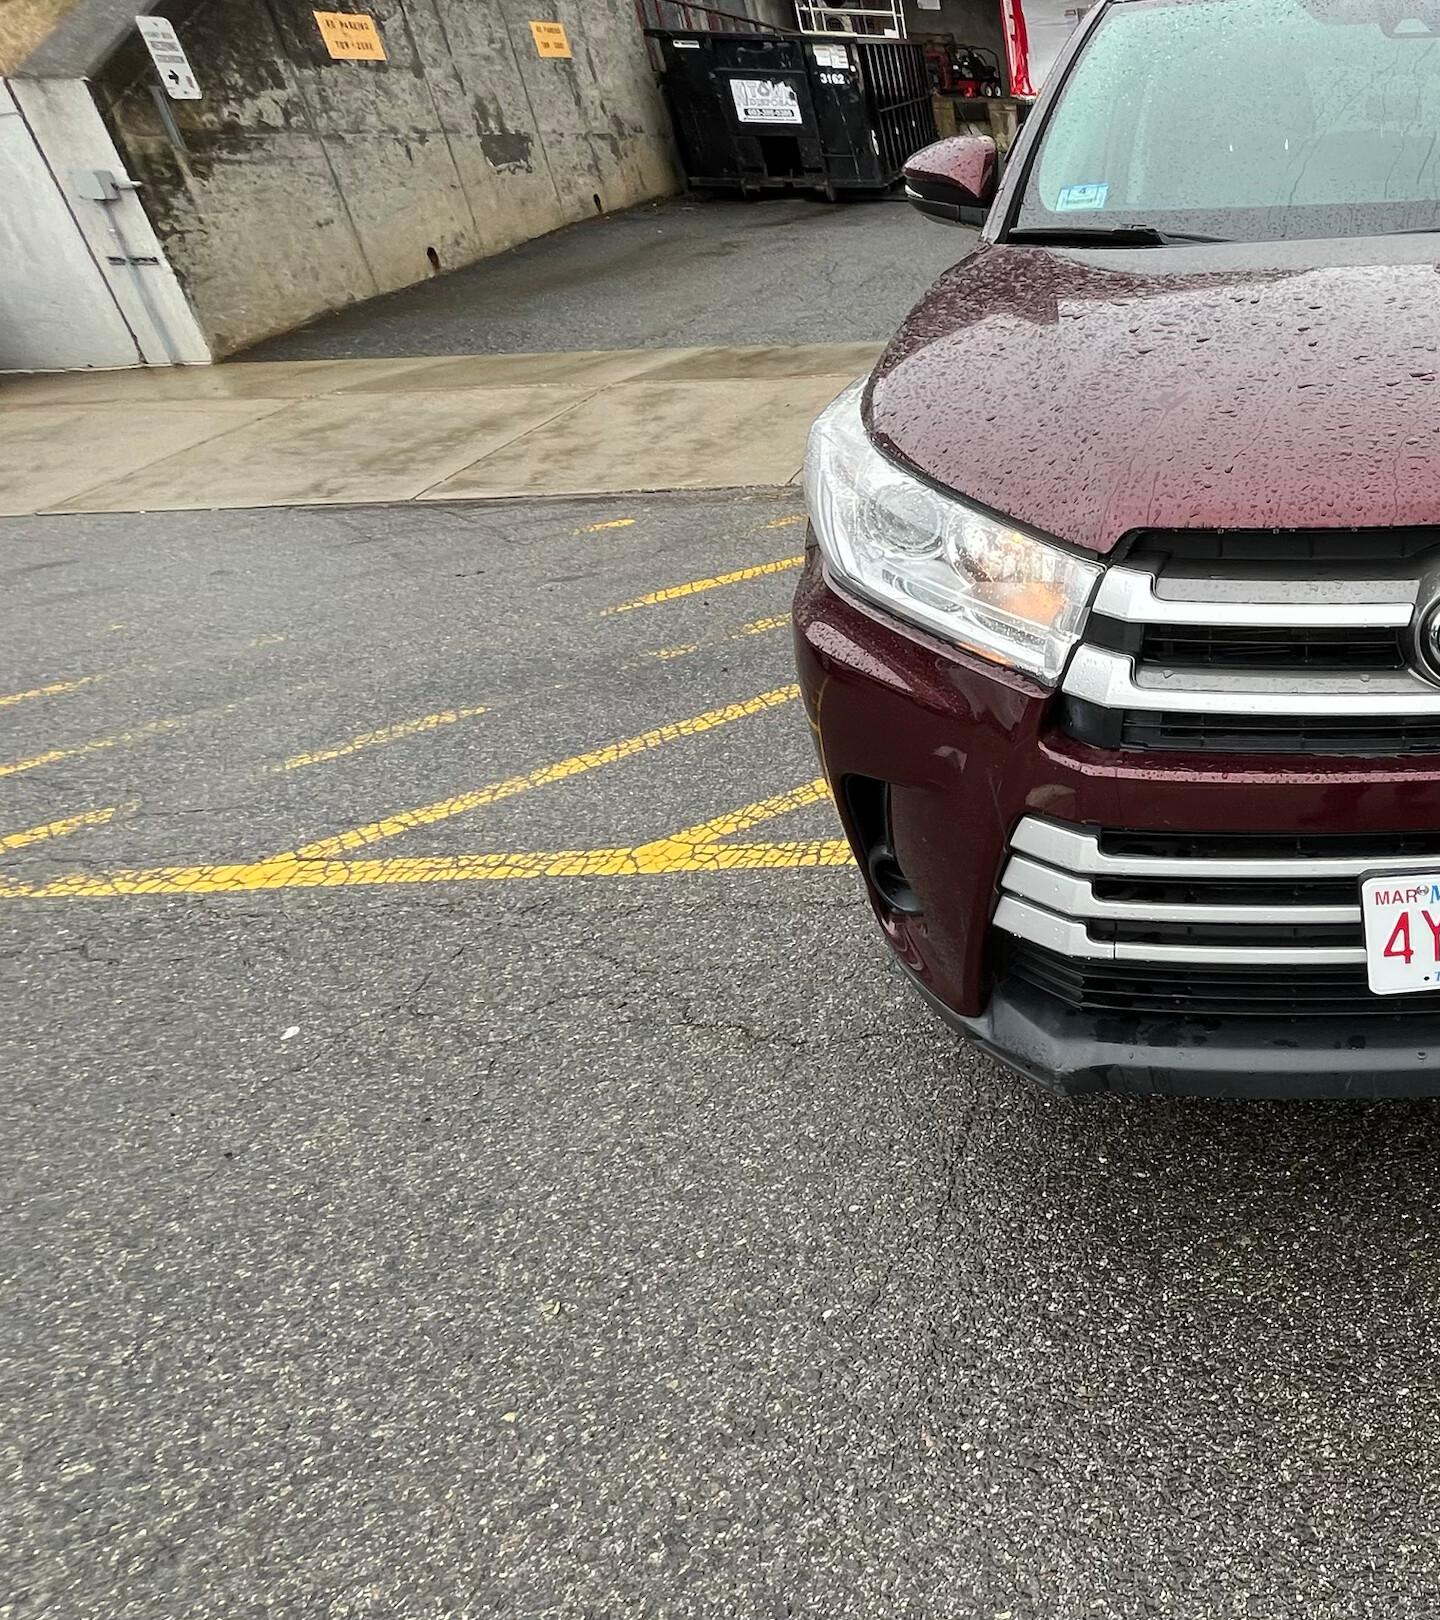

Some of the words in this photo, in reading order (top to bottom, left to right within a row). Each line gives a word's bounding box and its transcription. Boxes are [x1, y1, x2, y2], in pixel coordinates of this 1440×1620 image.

[339, 21, 369, 30] PARKING
[820, 72, 845, 85] 3162
[1375, 889, 1418, 905] MAR
